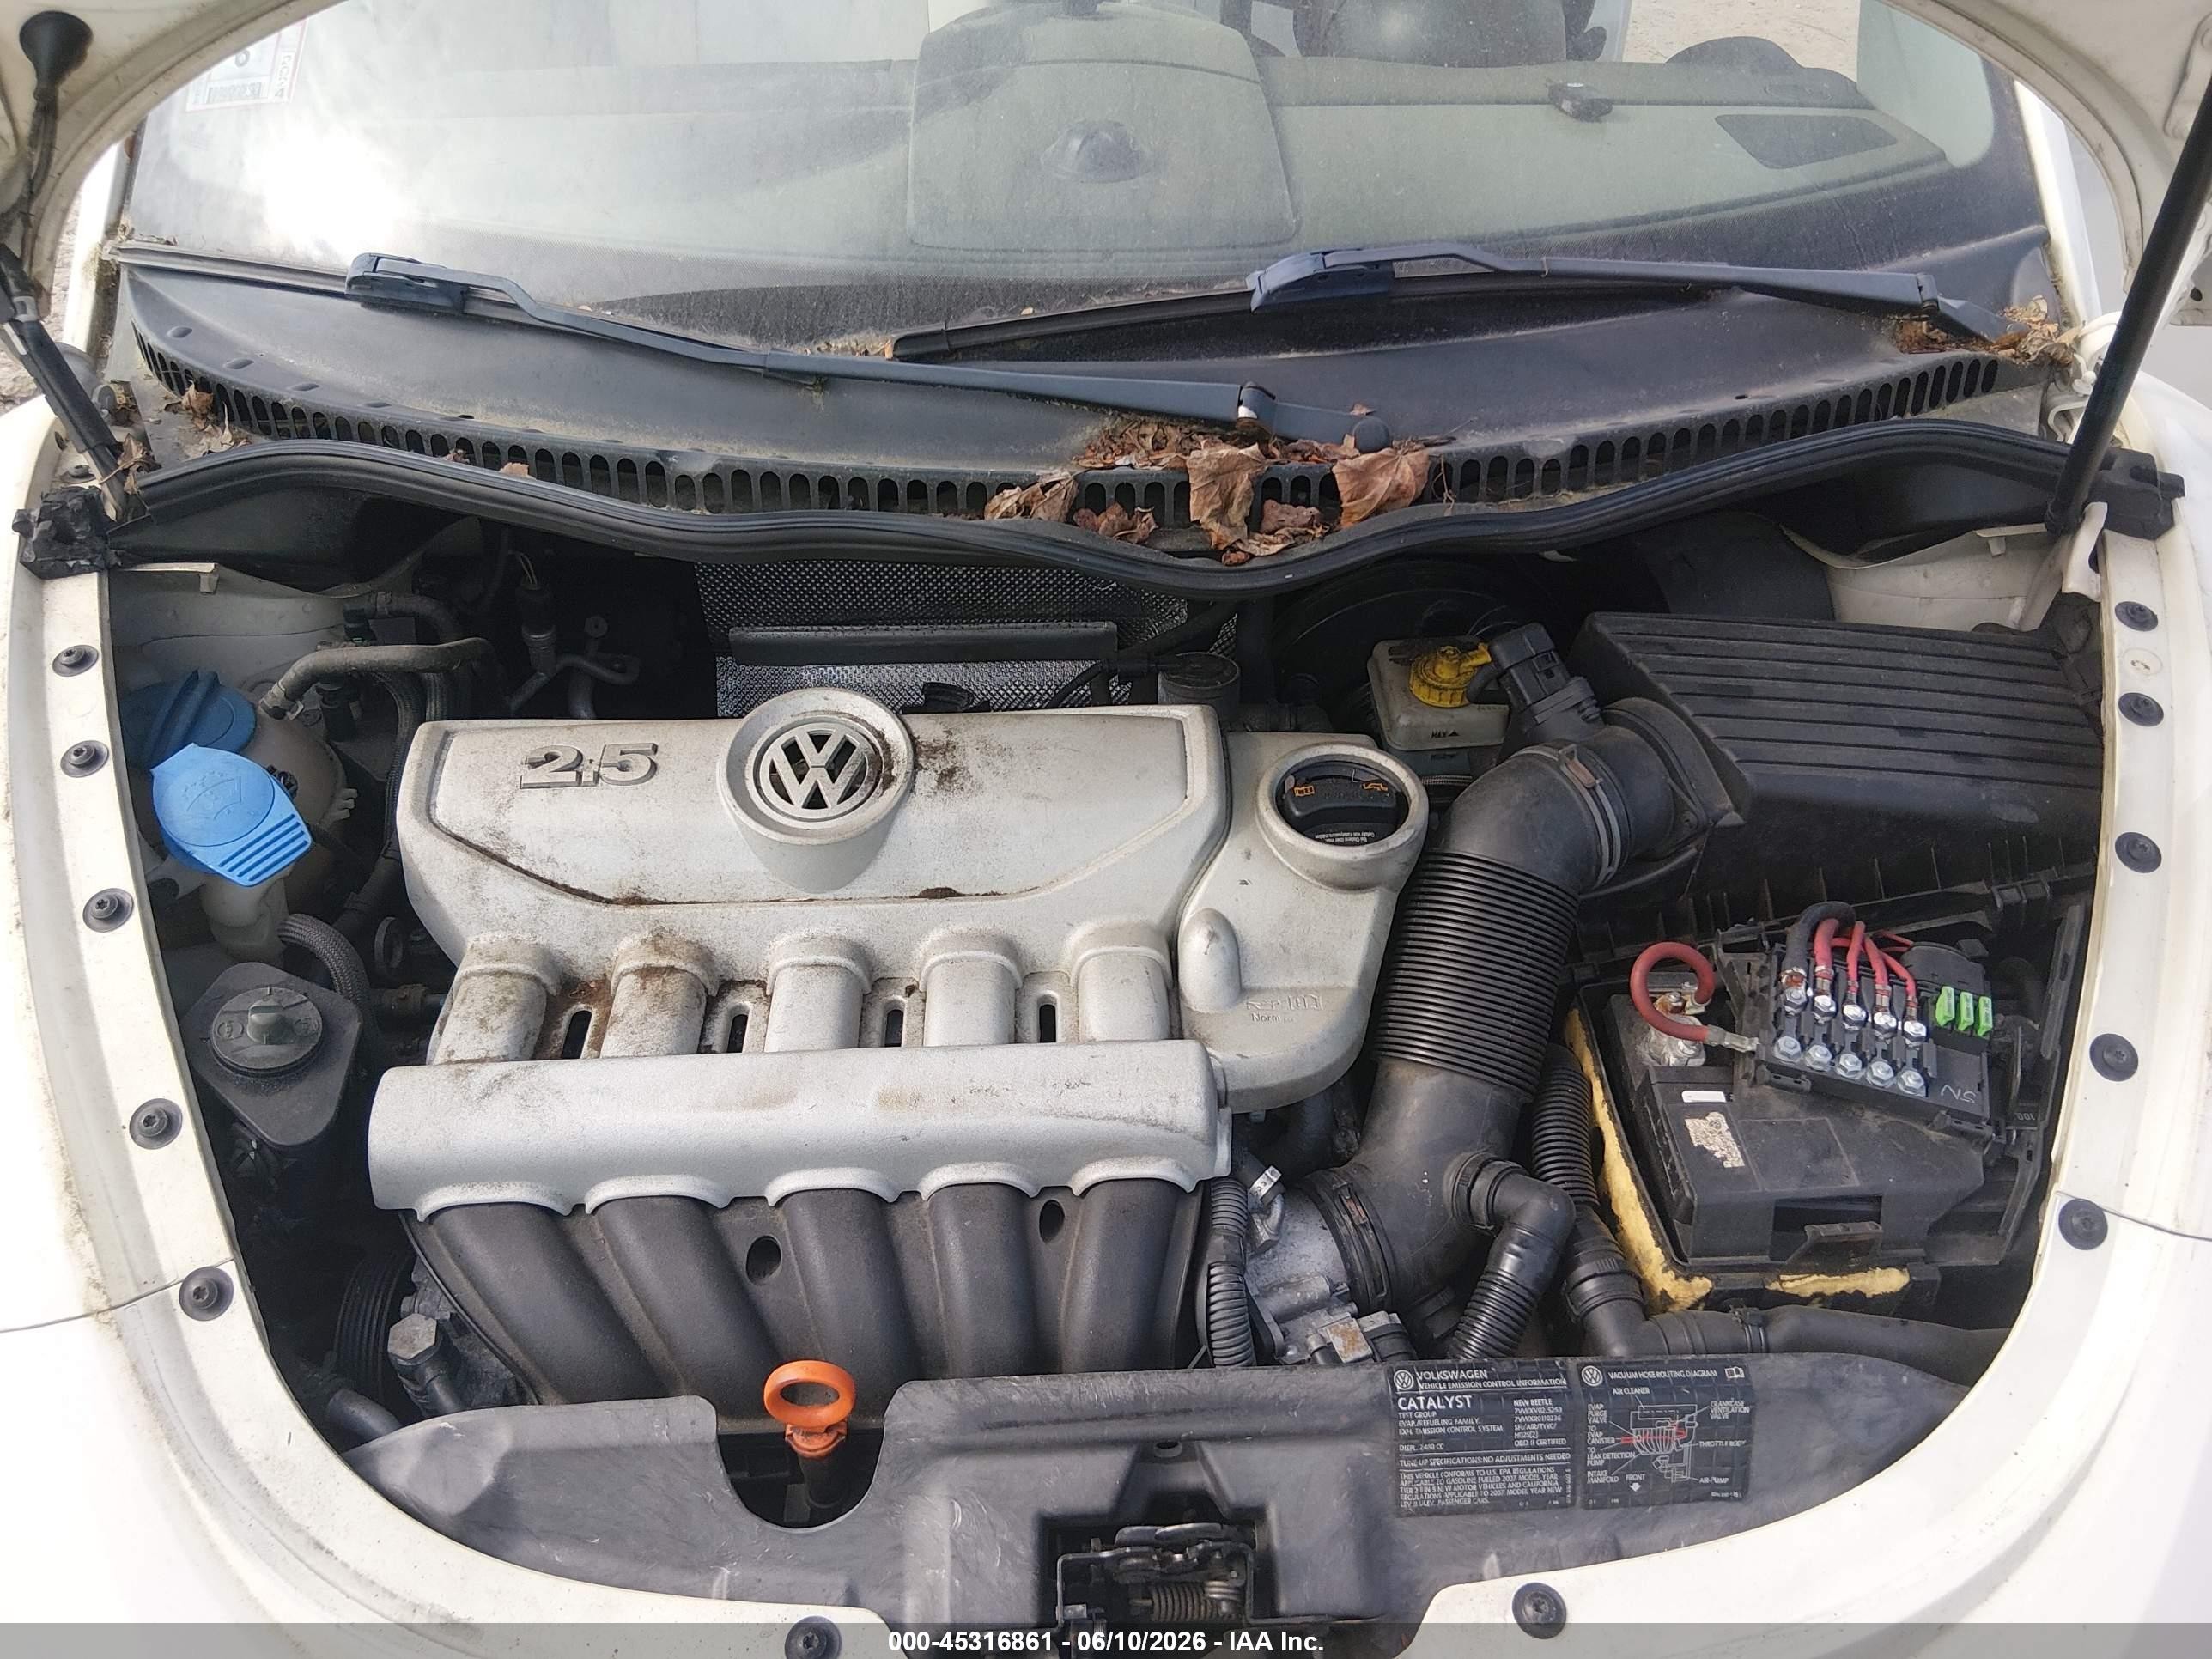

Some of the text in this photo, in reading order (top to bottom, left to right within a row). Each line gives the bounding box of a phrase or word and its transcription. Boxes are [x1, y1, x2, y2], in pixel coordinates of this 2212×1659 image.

[1416, 1369, 1488, 1381] VOLKSWAGEN
[1397, 1395, 1472, 1410] CATALYST
[1495, 1455, 1543, 1463] ADJUSTMENTS
